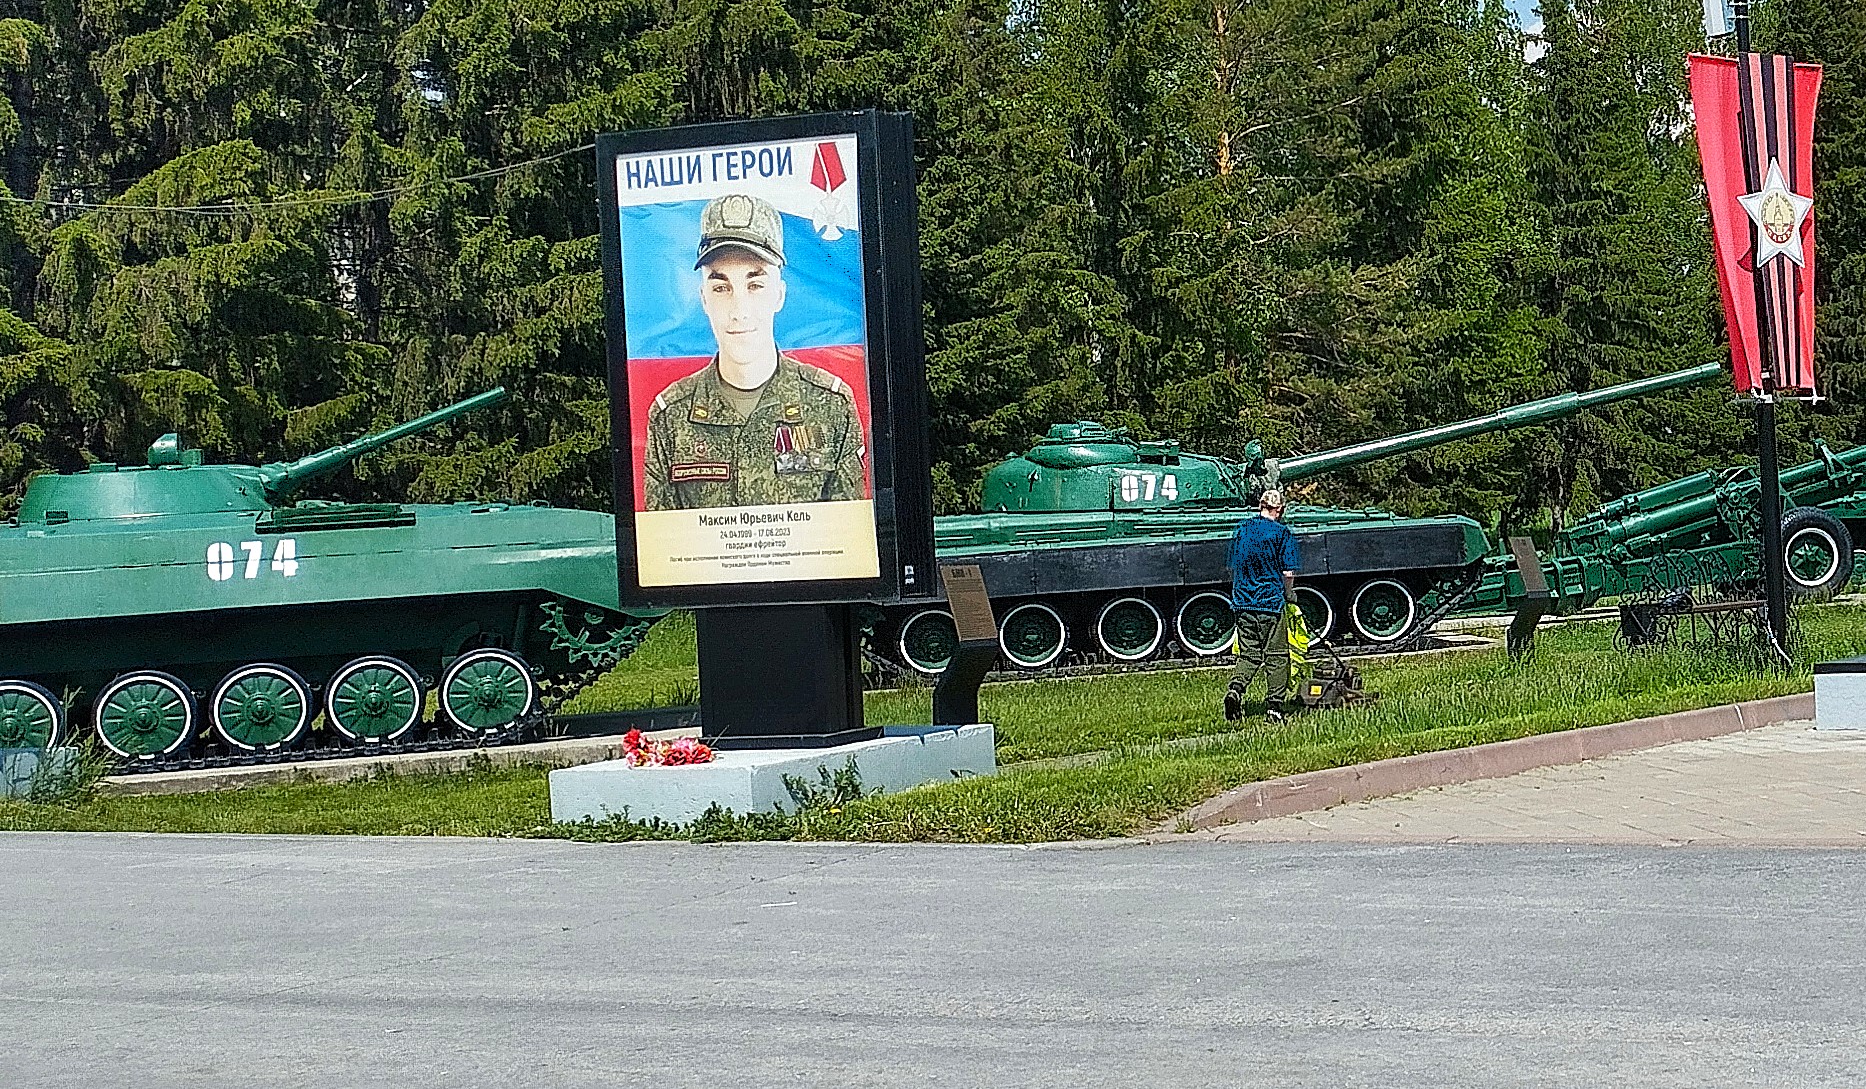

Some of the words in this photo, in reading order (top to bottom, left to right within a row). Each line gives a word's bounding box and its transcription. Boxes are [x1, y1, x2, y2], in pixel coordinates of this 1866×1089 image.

[626, 154, 702, 189] НАШИ
[712, 146, 793, 182] ГЕРОИ
[1121, 474, 1179, 502] 074
[699, 514, 737, 526] Максим
[740, 512, 784, 526] Юрьевич
[787, 510, 811, 522] Кель
[206, 538, 299, 581] 074
